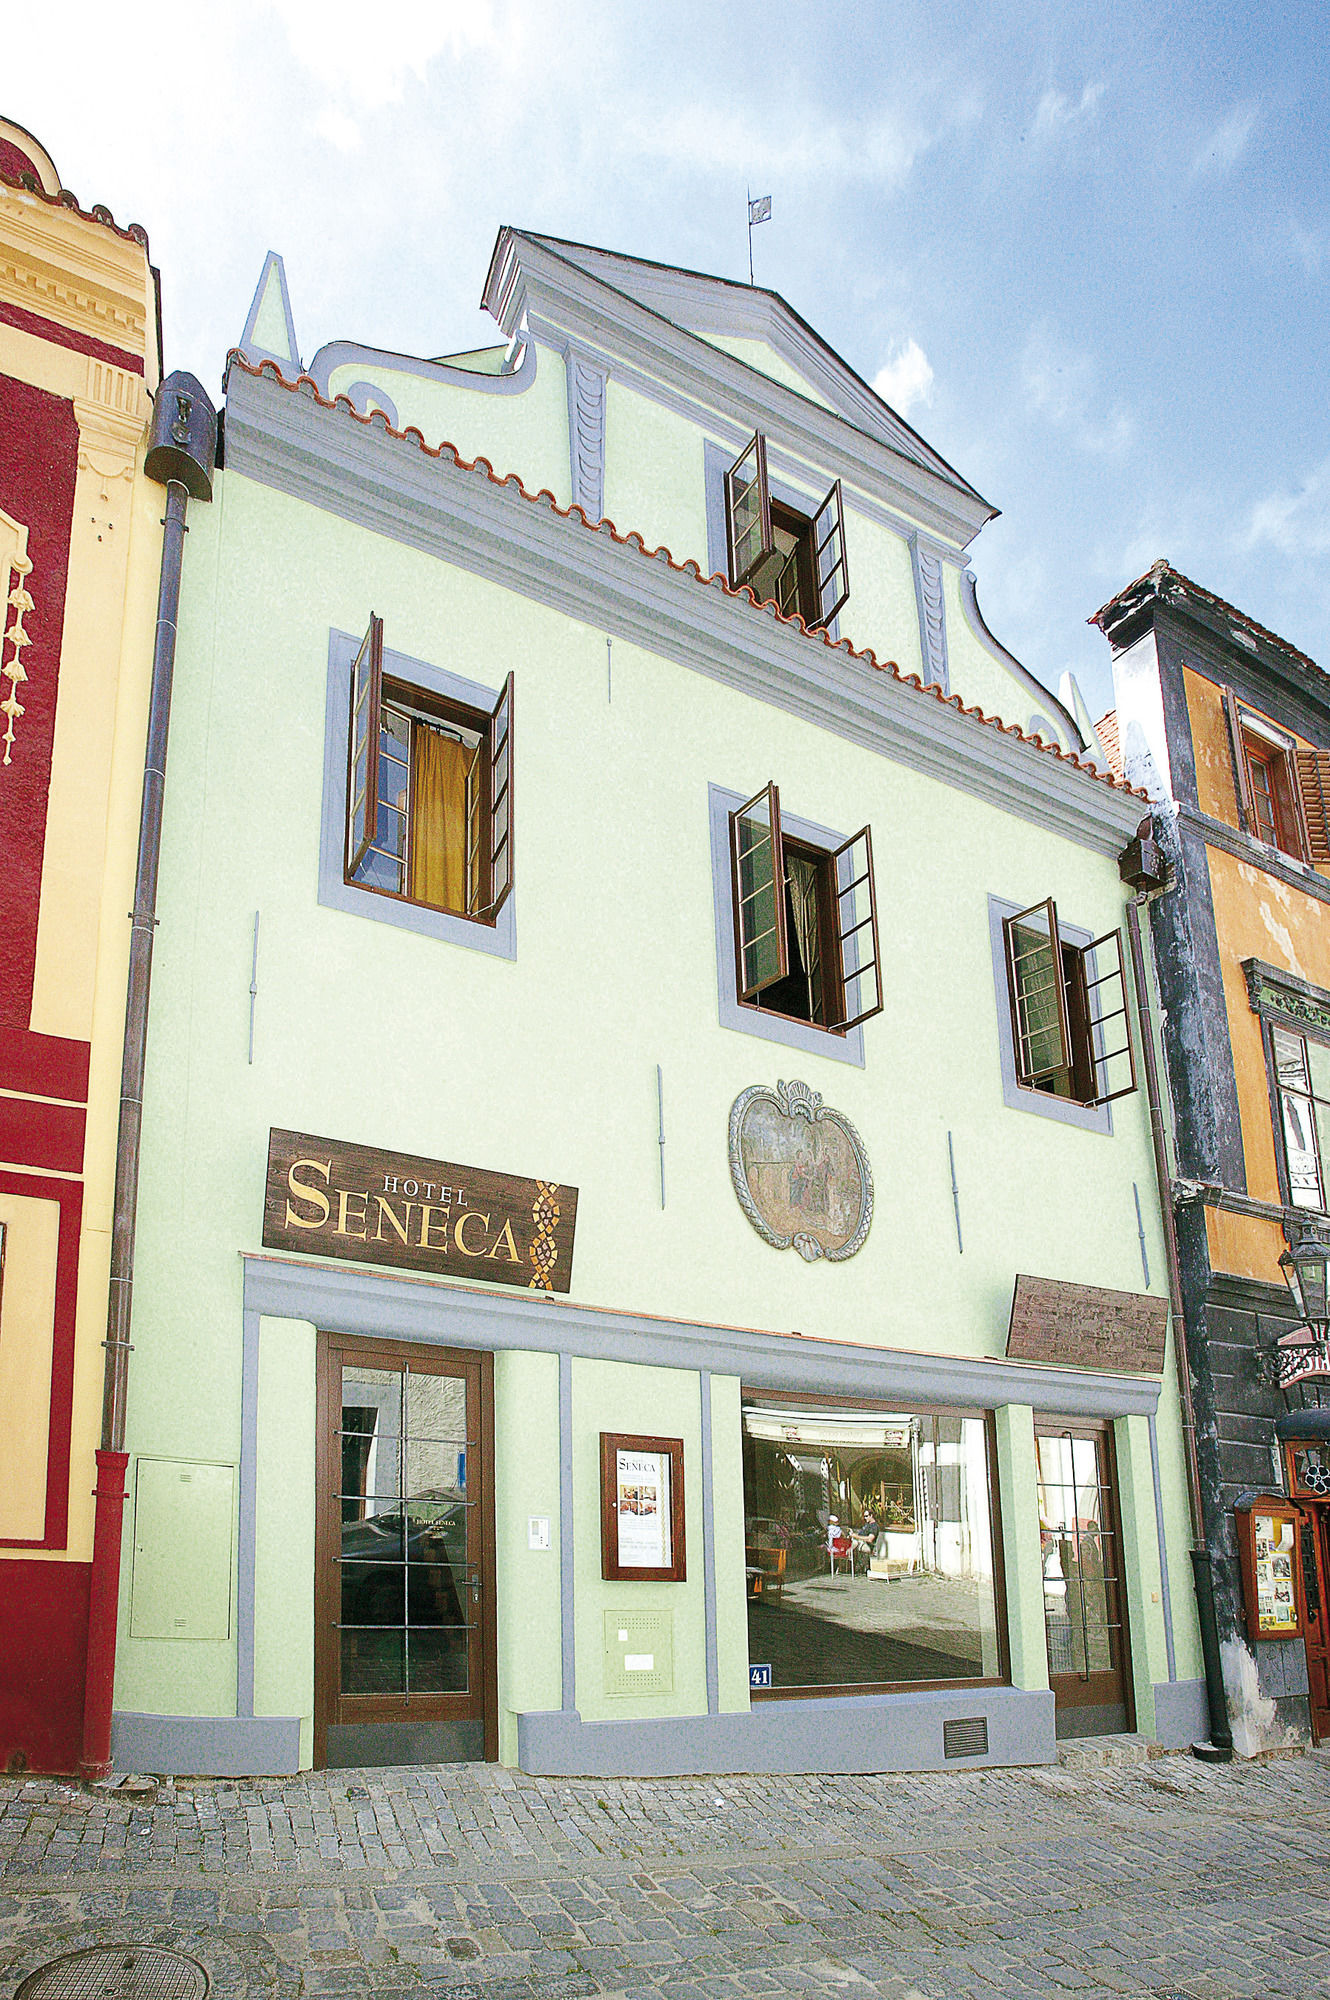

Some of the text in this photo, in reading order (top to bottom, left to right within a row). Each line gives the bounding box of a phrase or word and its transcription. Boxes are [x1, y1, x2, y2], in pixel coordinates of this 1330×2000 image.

[383, 1175, 468, 1207] HOTEL
[284, 1158, 524, 1264] SENECA
[751, 1669, 768, 1684] 41
